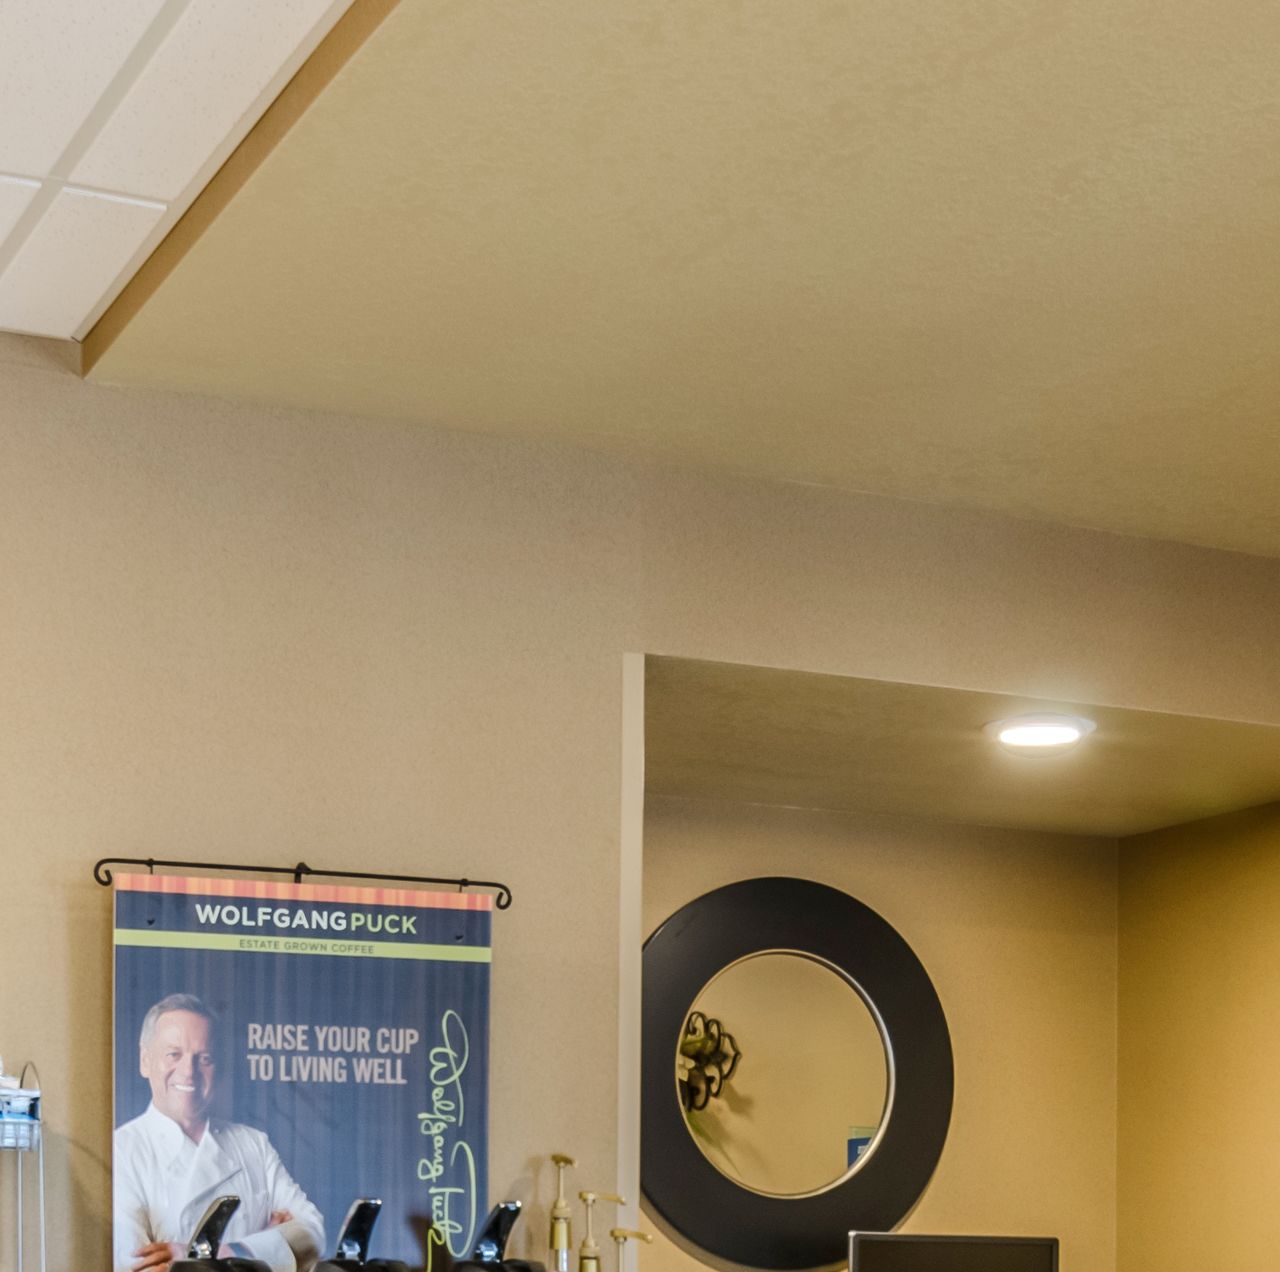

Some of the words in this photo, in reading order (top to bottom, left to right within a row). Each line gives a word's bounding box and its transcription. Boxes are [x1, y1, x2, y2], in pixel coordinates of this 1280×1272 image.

[239, 938, 280, 951] ESTATE
[284, 941, 328, 953] GROWN
[331, 943, 375, 955] COFFEE
[247, 1023, 309, 1051] RAISE
[314, 1025, 371, 1053] YOUR
[376, 1028, 420, 1054] CUP
[246, 1054, 274, 1082] TO
[279, 1055, 348, 1083] LIVING
[352, 1057, 408, 1085] WELL
